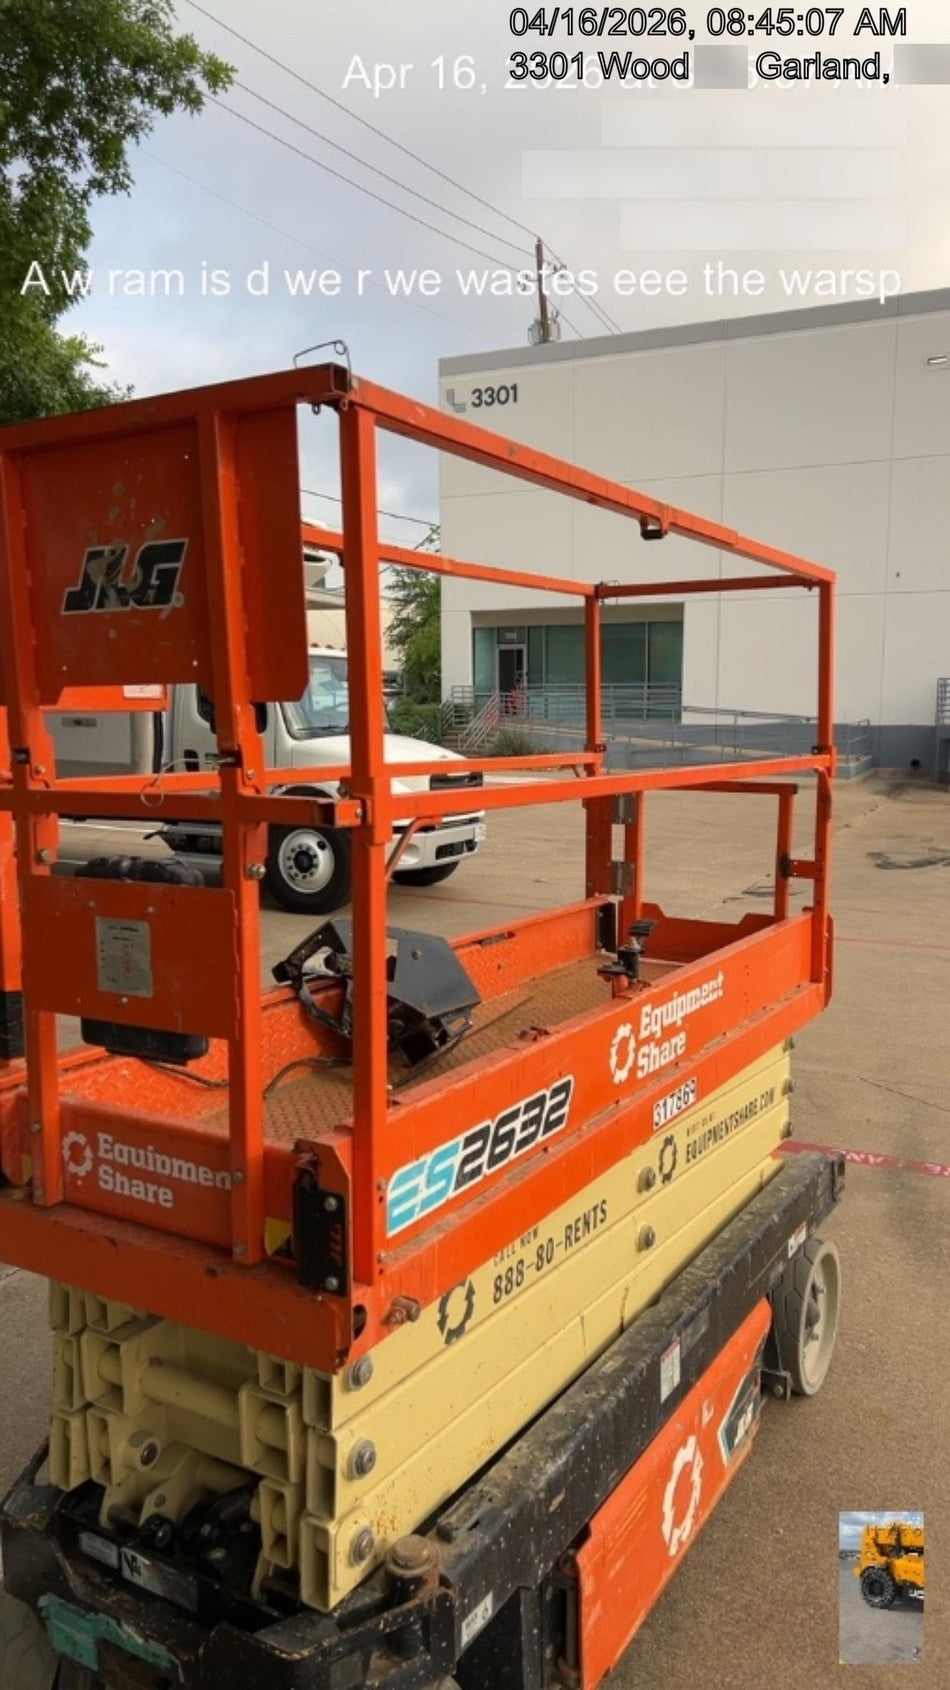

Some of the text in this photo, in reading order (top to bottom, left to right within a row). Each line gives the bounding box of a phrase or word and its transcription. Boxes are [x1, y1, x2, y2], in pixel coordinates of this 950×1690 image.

[471, 383, 518, 408] 3301
[638, 971, 724, 1040] Equipment
[636, 1031, 687, 1079] Share
[97, 1163, 174, 1208] Share
[387, 1074, 574, 1239] ES2632
[492, 1198, 608, 1304] 888-80-RENTS
